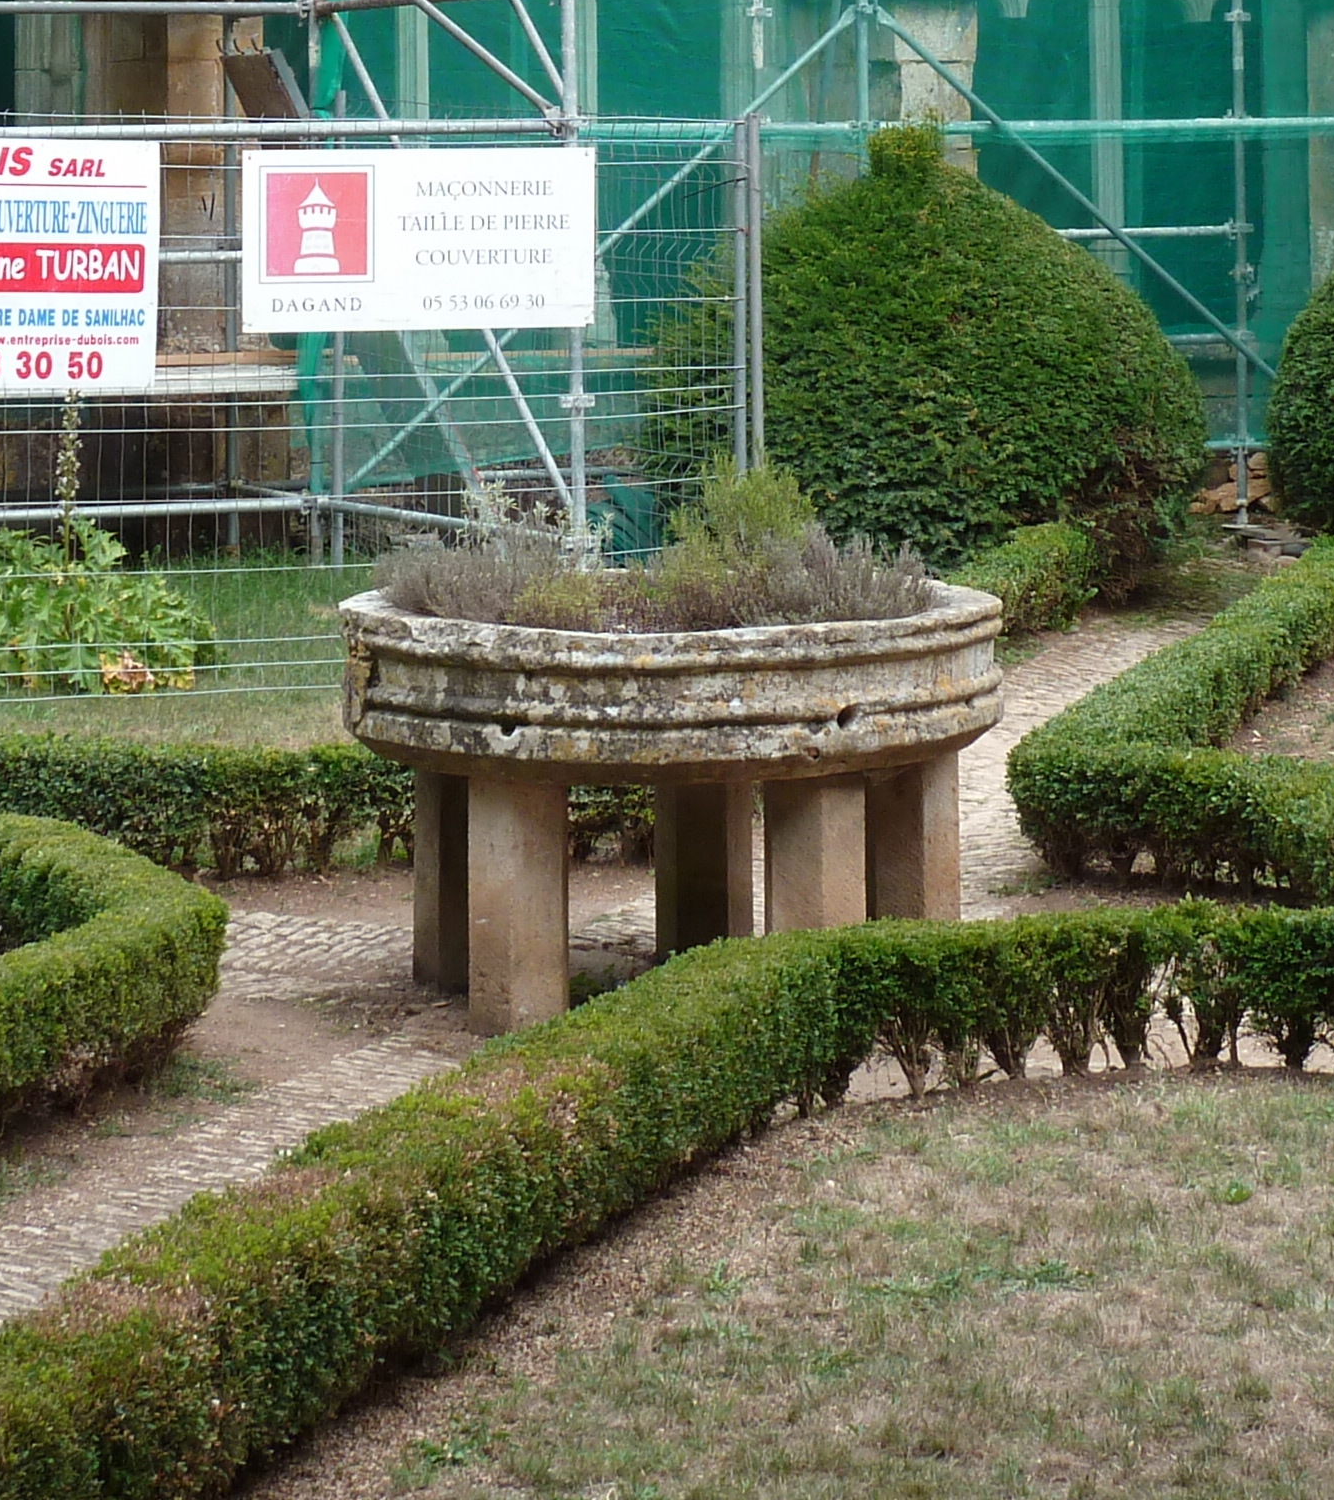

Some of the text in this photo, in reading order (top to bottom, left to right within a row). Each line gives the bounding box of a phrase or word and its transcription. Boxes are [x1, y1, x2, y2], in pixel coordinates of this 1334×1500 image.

[48, 158, 106, 177] SARL
[416, 180, 553, 200] MAÇONNERIE
[397, 213, 570, 231] TAILLE DE PIERRE
[35, 249, 139, 281] TURBAN
[415, 248, 553, 266] COUVERTURE
[271, 297, 363, 312] DAGAND
[422, 293, 545, 311] 05 53 06 69 30
[18, 308, 56, 327] DAME
[62, 309, 79, 327] DE
[85, 308, 145, 327] SANILHAC
[16, 351, 53, 380] 30
[68, 351, 103, 380] 50
